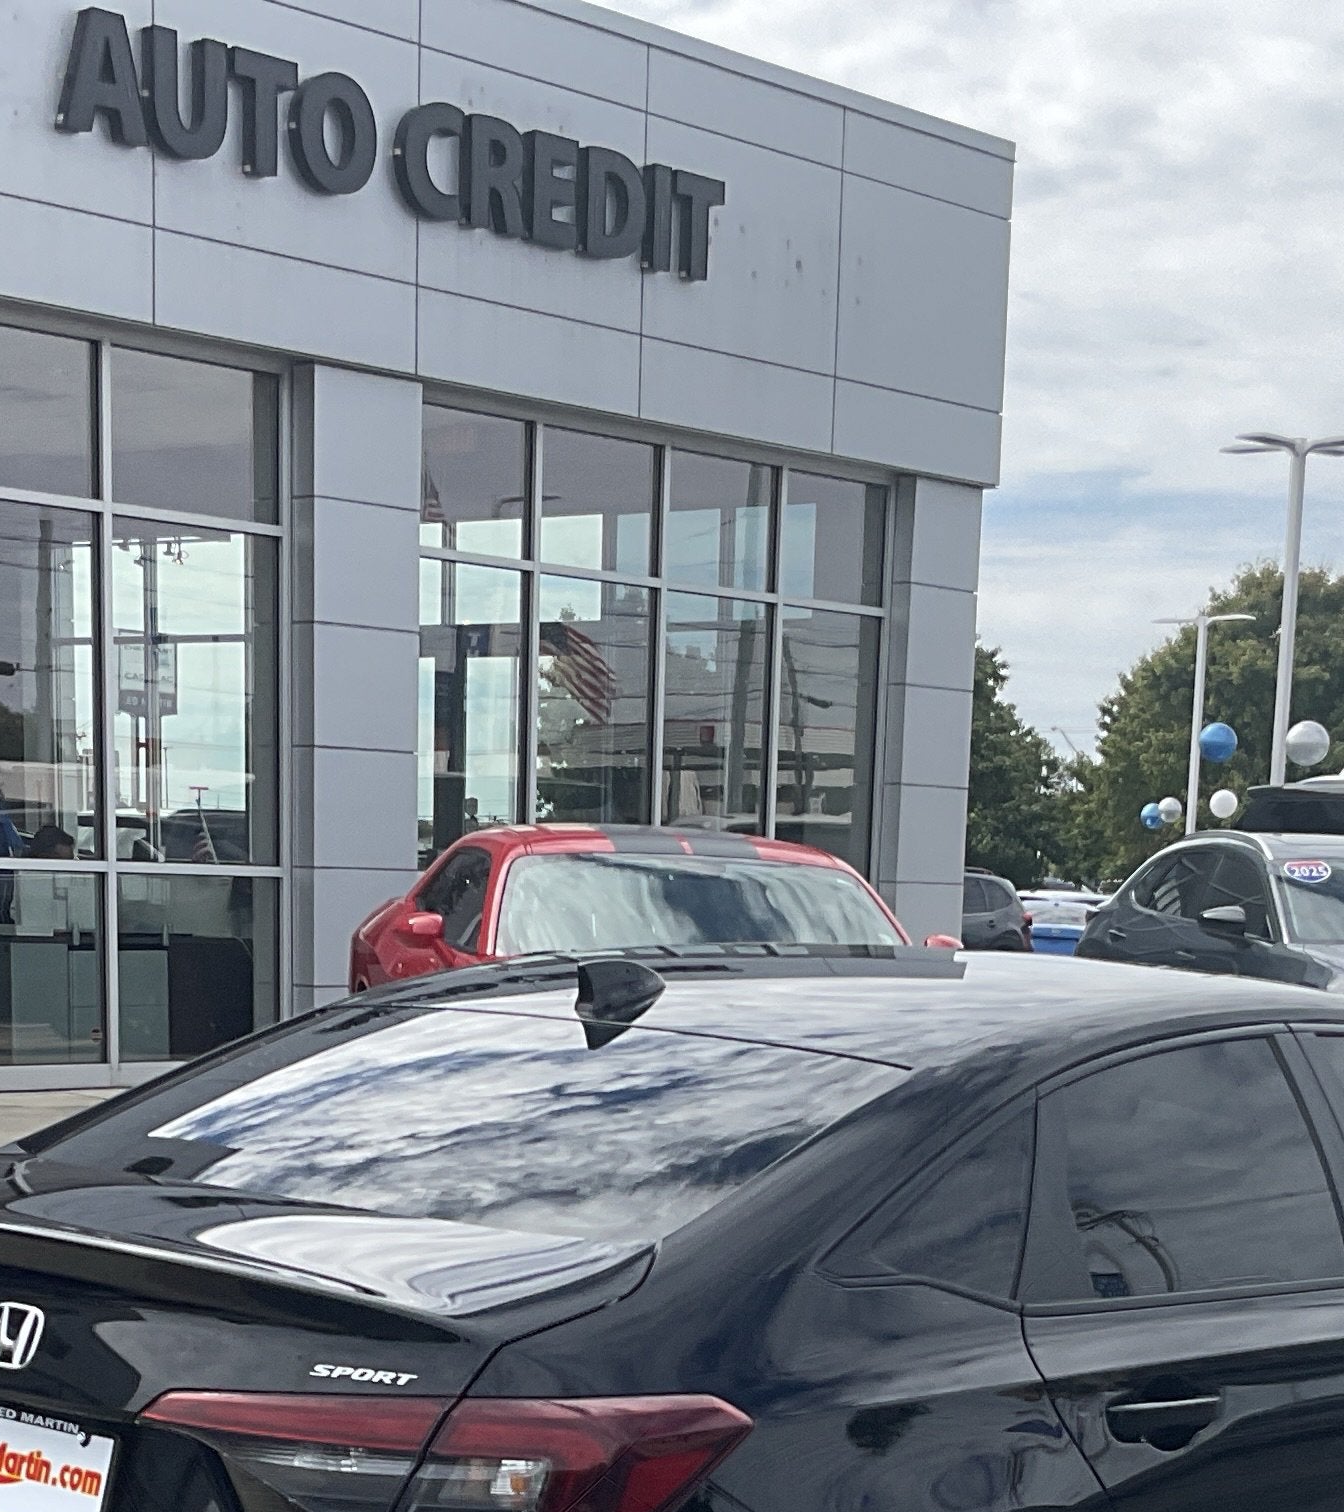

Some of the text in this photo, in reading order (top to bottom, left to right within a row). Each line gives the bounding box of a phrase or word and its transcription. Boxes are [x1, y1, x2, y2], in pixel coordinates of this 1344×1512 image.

[56, 6, 725, 281] AUTO CREDIT
[1290, 865, 1328, 877] 2025
[309, 1364, 418, 1386] SPORT
[20, 1412, 80, 1434] MARTIN
